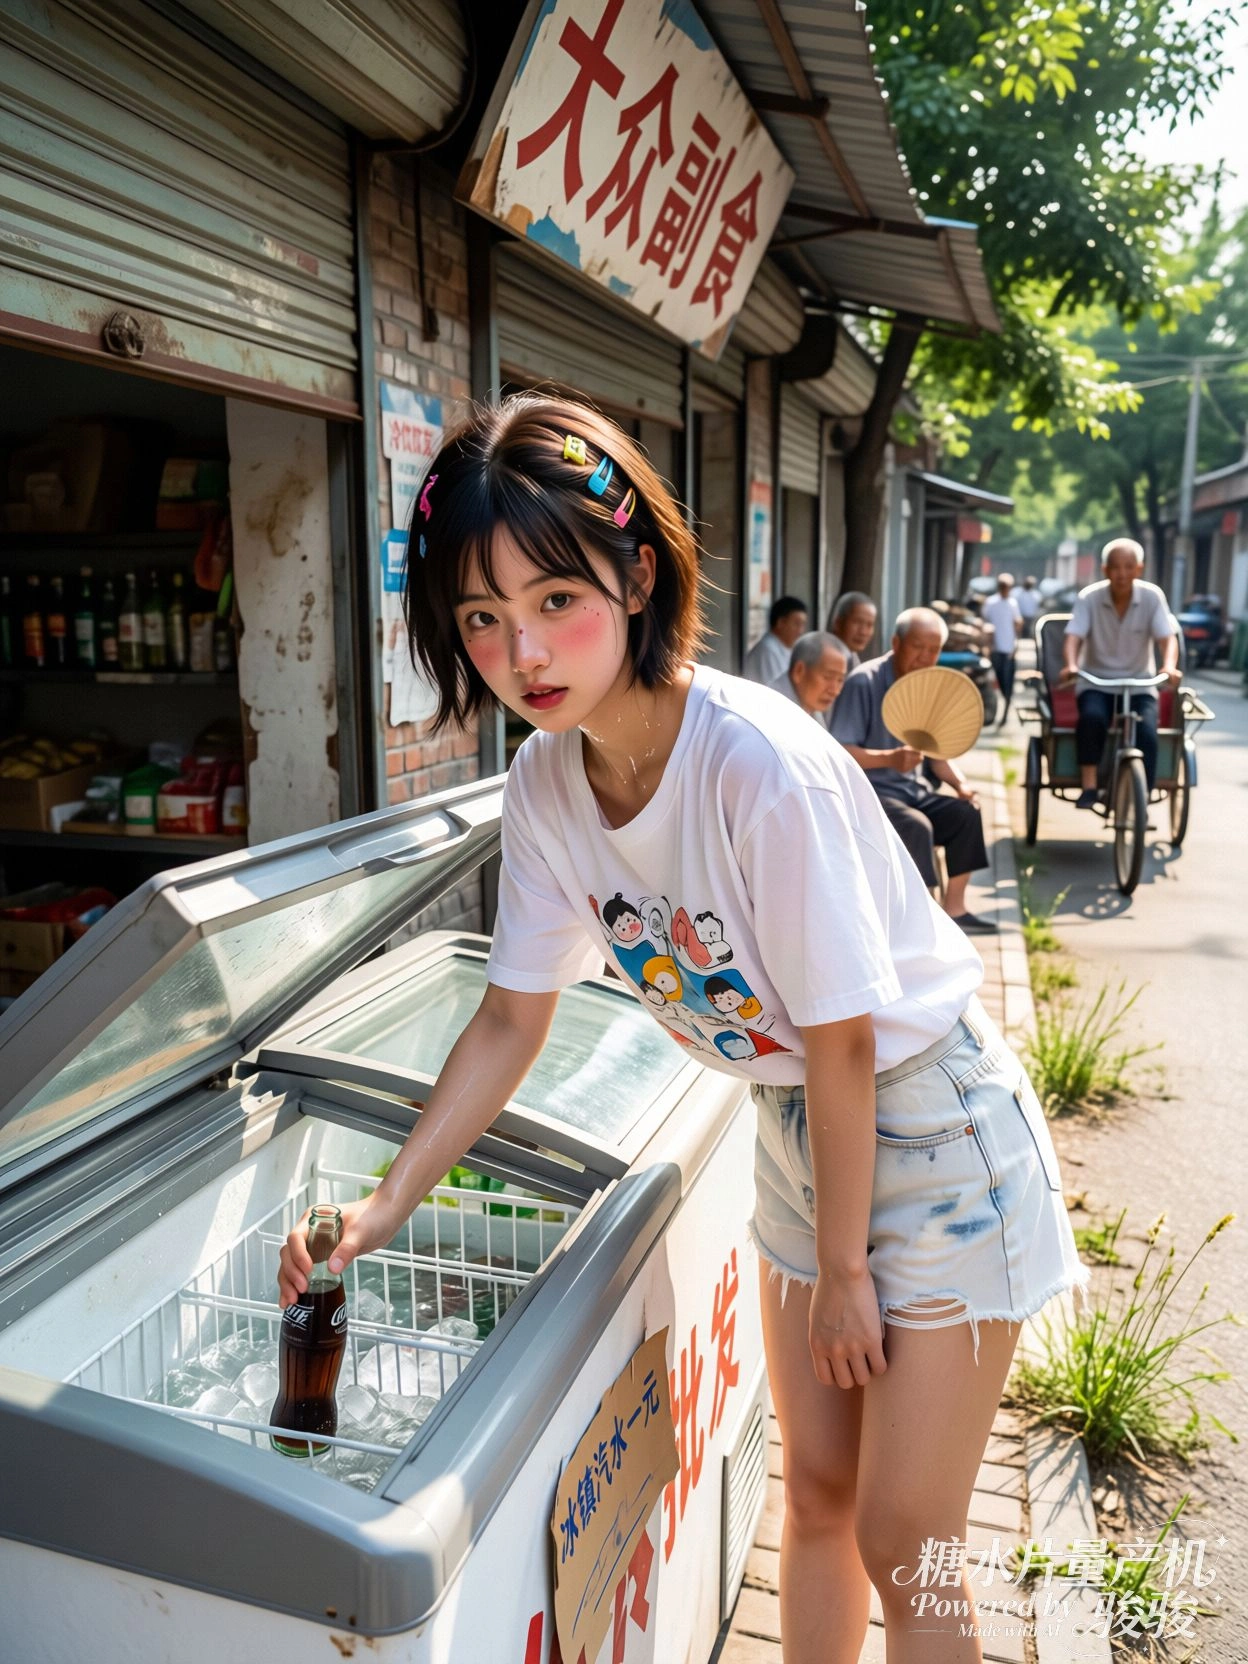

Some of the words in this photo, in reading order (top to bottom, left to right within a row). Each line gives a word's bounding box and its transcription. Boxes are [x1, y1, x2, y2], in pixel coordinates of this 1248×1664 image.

[516, 0, 762, 319] 大众副食
[560, 1369, 660, 1565] 冰镇汽水一元
